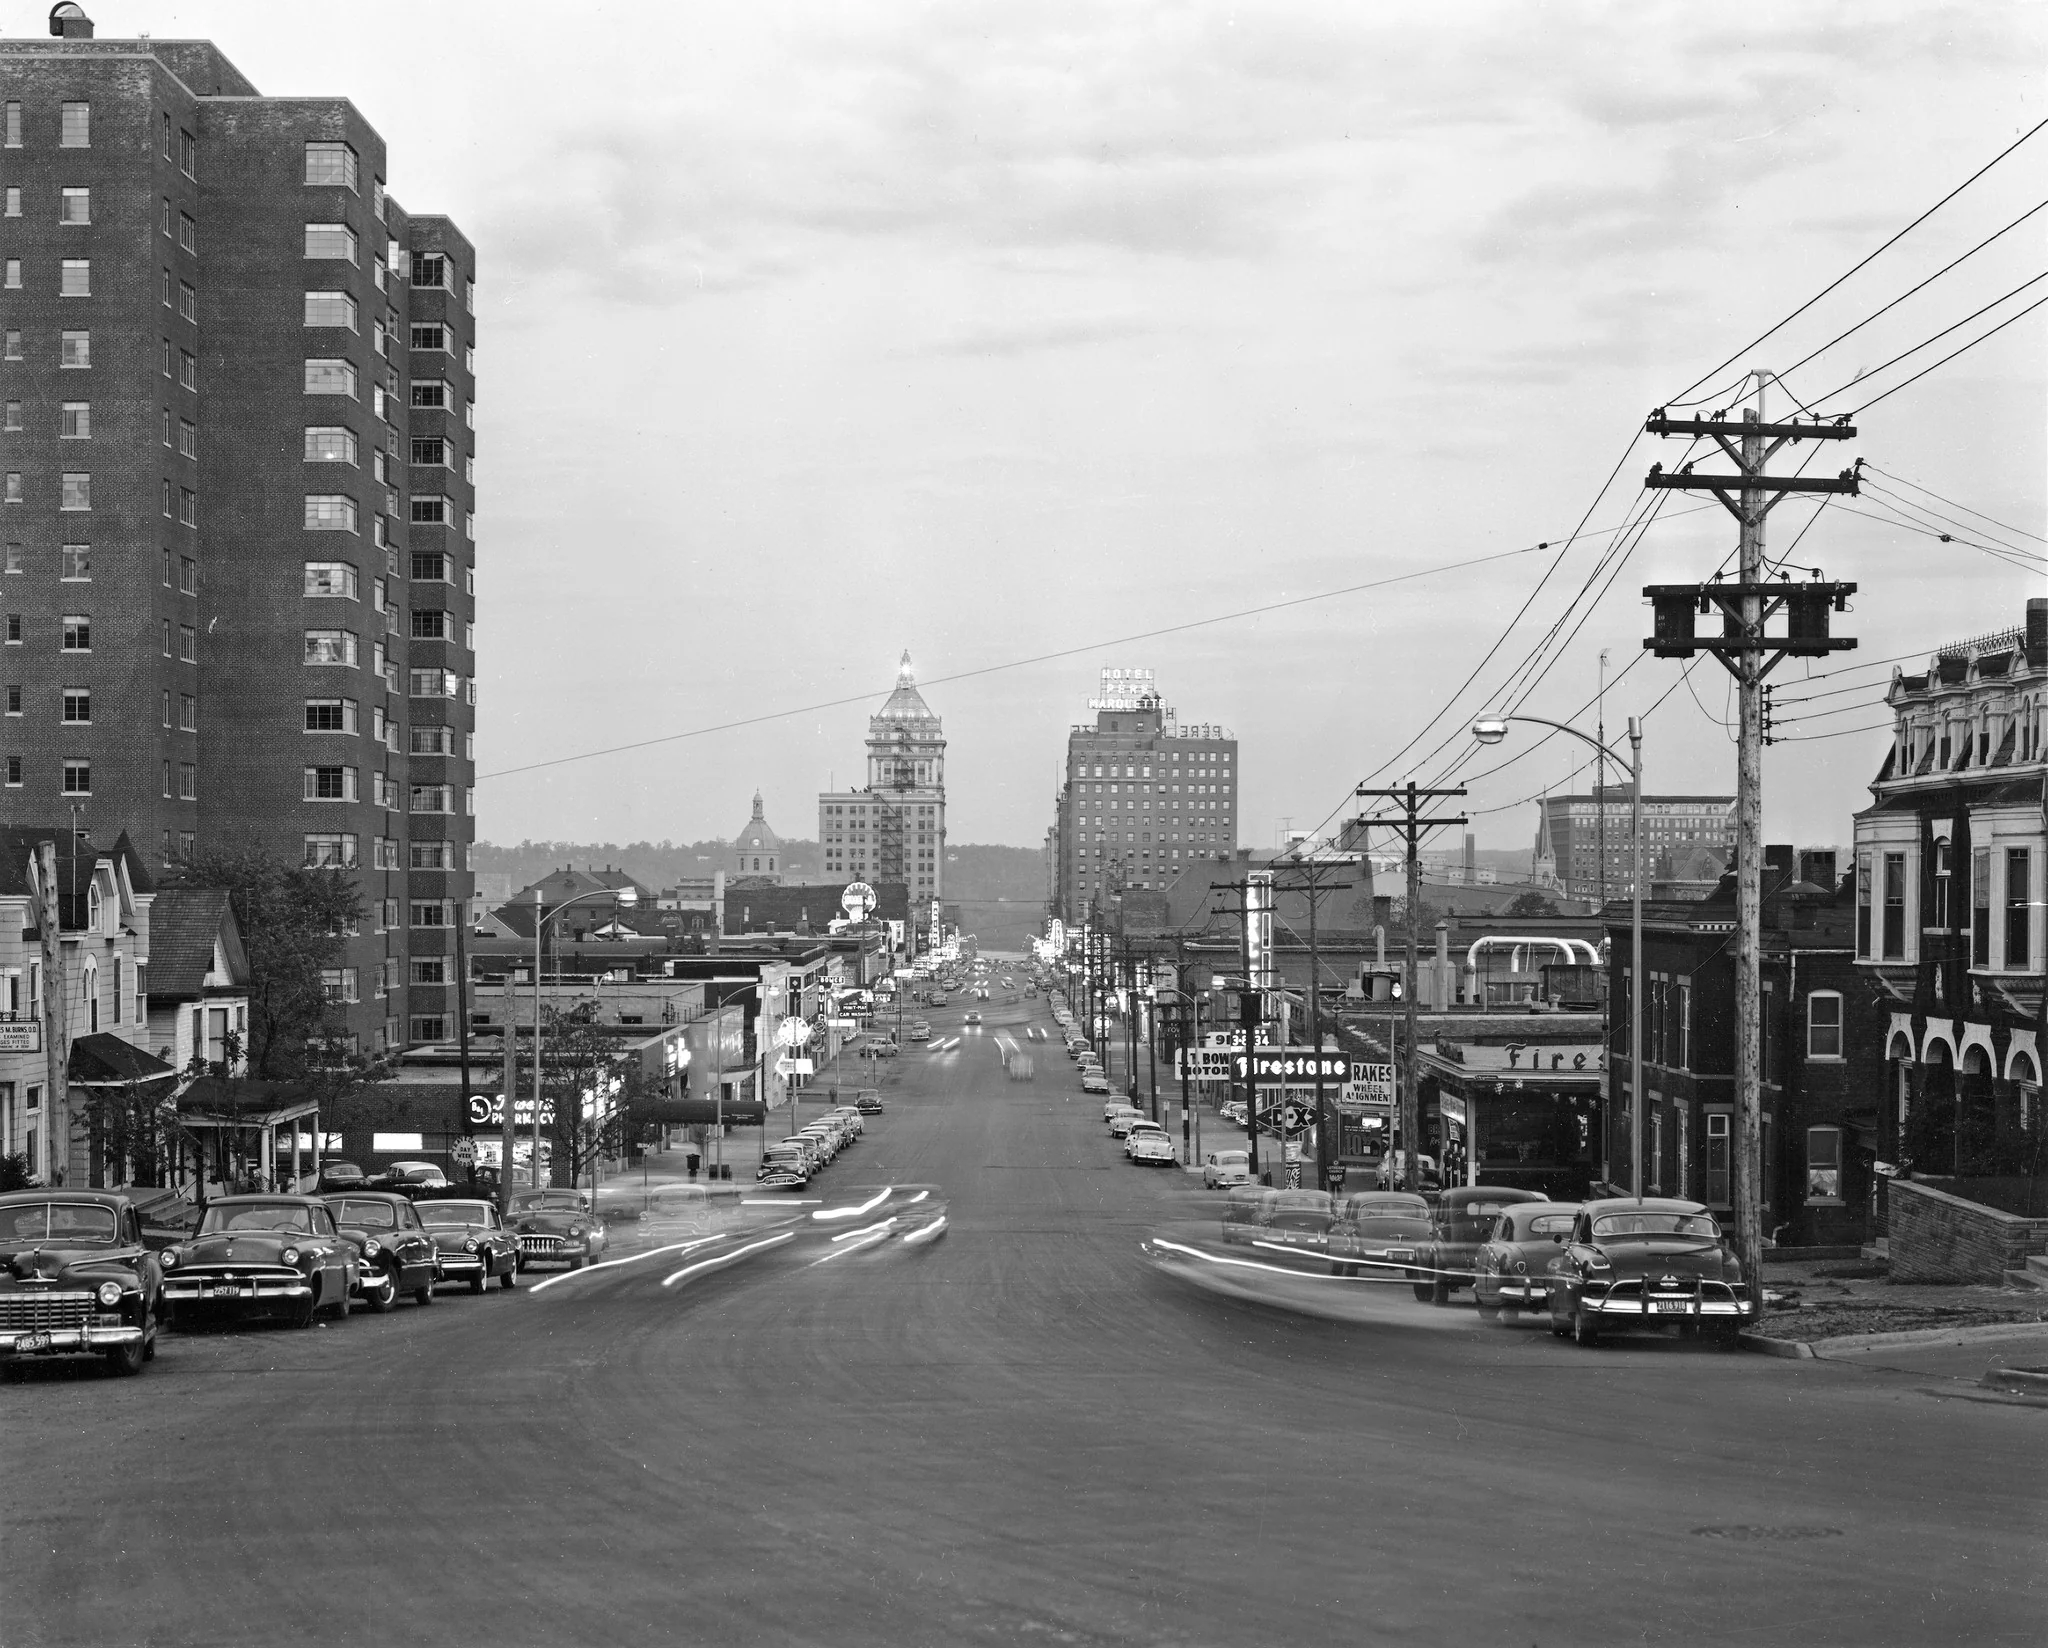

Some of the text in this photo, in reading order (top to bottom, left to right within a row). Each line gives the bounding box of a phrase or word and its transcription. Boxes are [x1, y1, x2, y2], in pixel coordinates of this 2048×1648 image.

[1102, 669, 1153, 679] HOTEL
[1088, 698, 1167, 709] MARQUETTE
[1232, 1035, 1270, 1046] 3-834
[1236, 1056, 1346, 1078] Firestone
[1353, 1064, 1391, 1082] RAKES
[1353, 1083, 1385, 1094] WHEEL
[1345, 1091, 1391, 1102] AIGNMEN
[491, 1112, 556, 1125] PHRMCY
